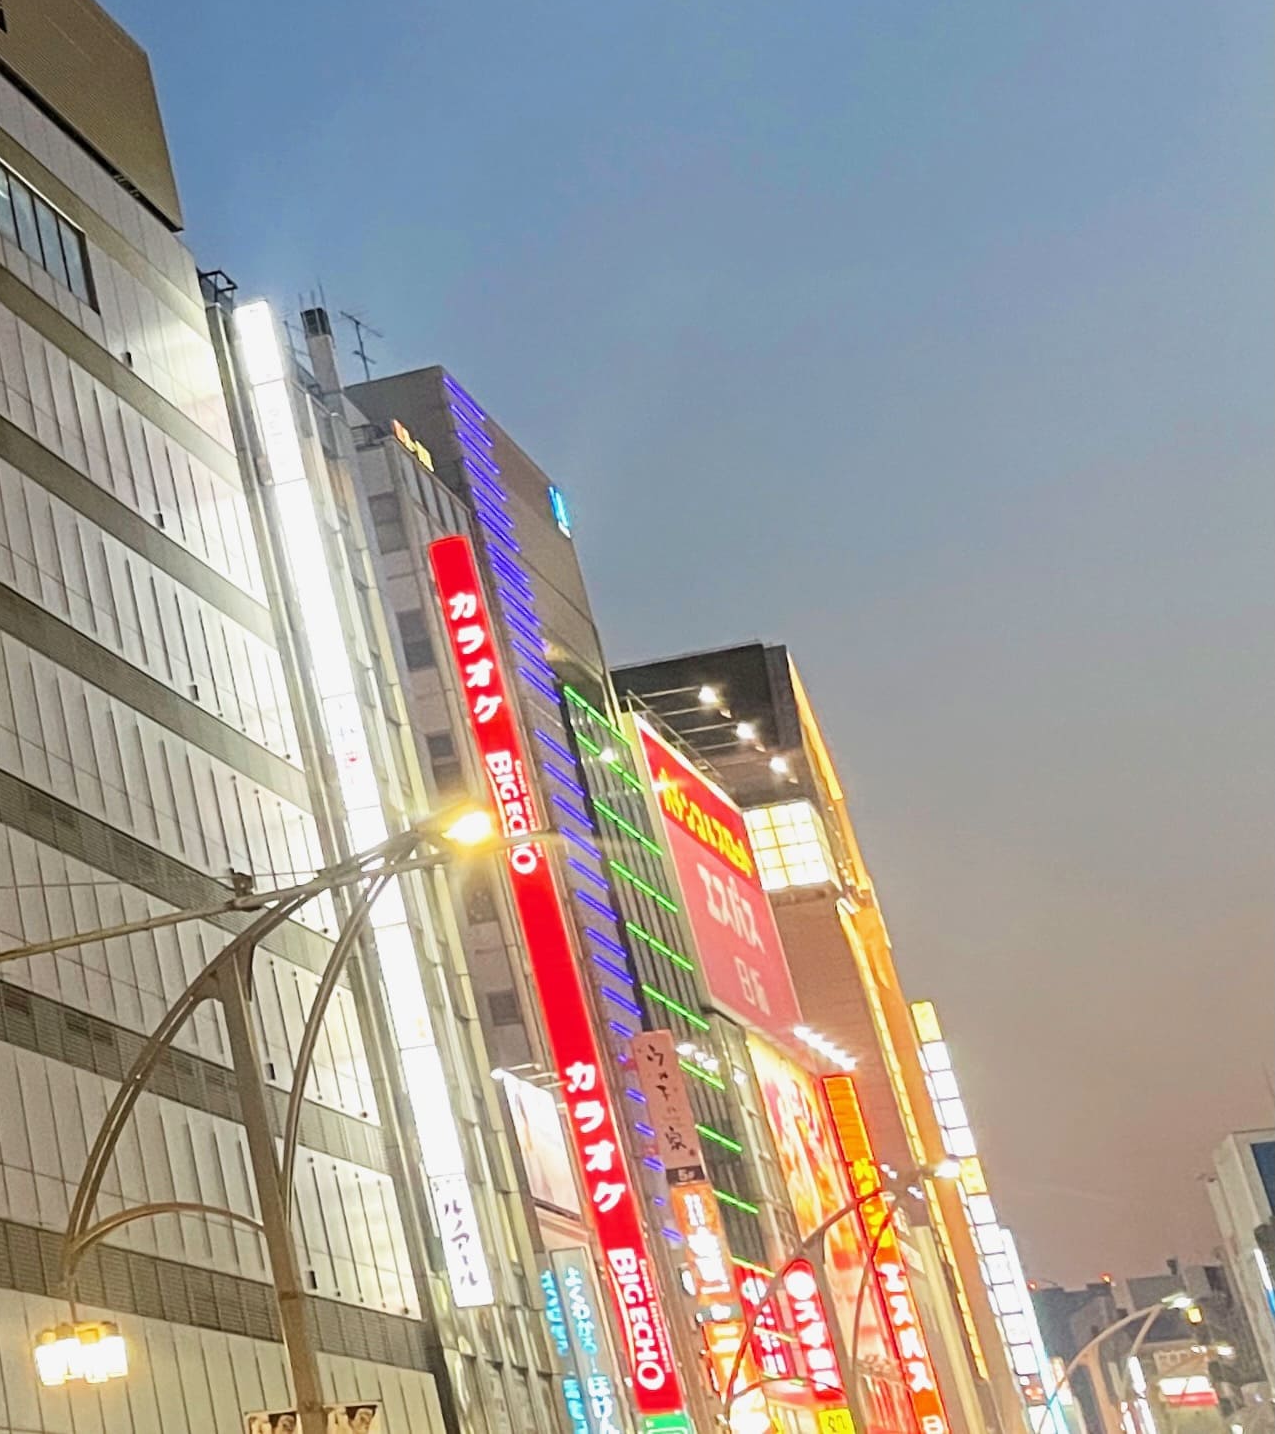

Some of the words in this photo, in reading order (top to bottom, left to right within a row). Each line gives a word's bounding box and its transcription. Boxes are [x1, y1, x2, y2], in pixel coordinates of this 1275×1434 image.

[448, 591, 503, 724] カラオケ
[485, 749, 519, 801] BIG
[565, 1061, 627, 1213] カラオケ
[443, 1198, 479, 1287] ルノアール
[606, 1247, 645, 1305] BIG
[628, 1305, 666, 1391] ECHO
[876, 1262, 934, 1393] エスパス
